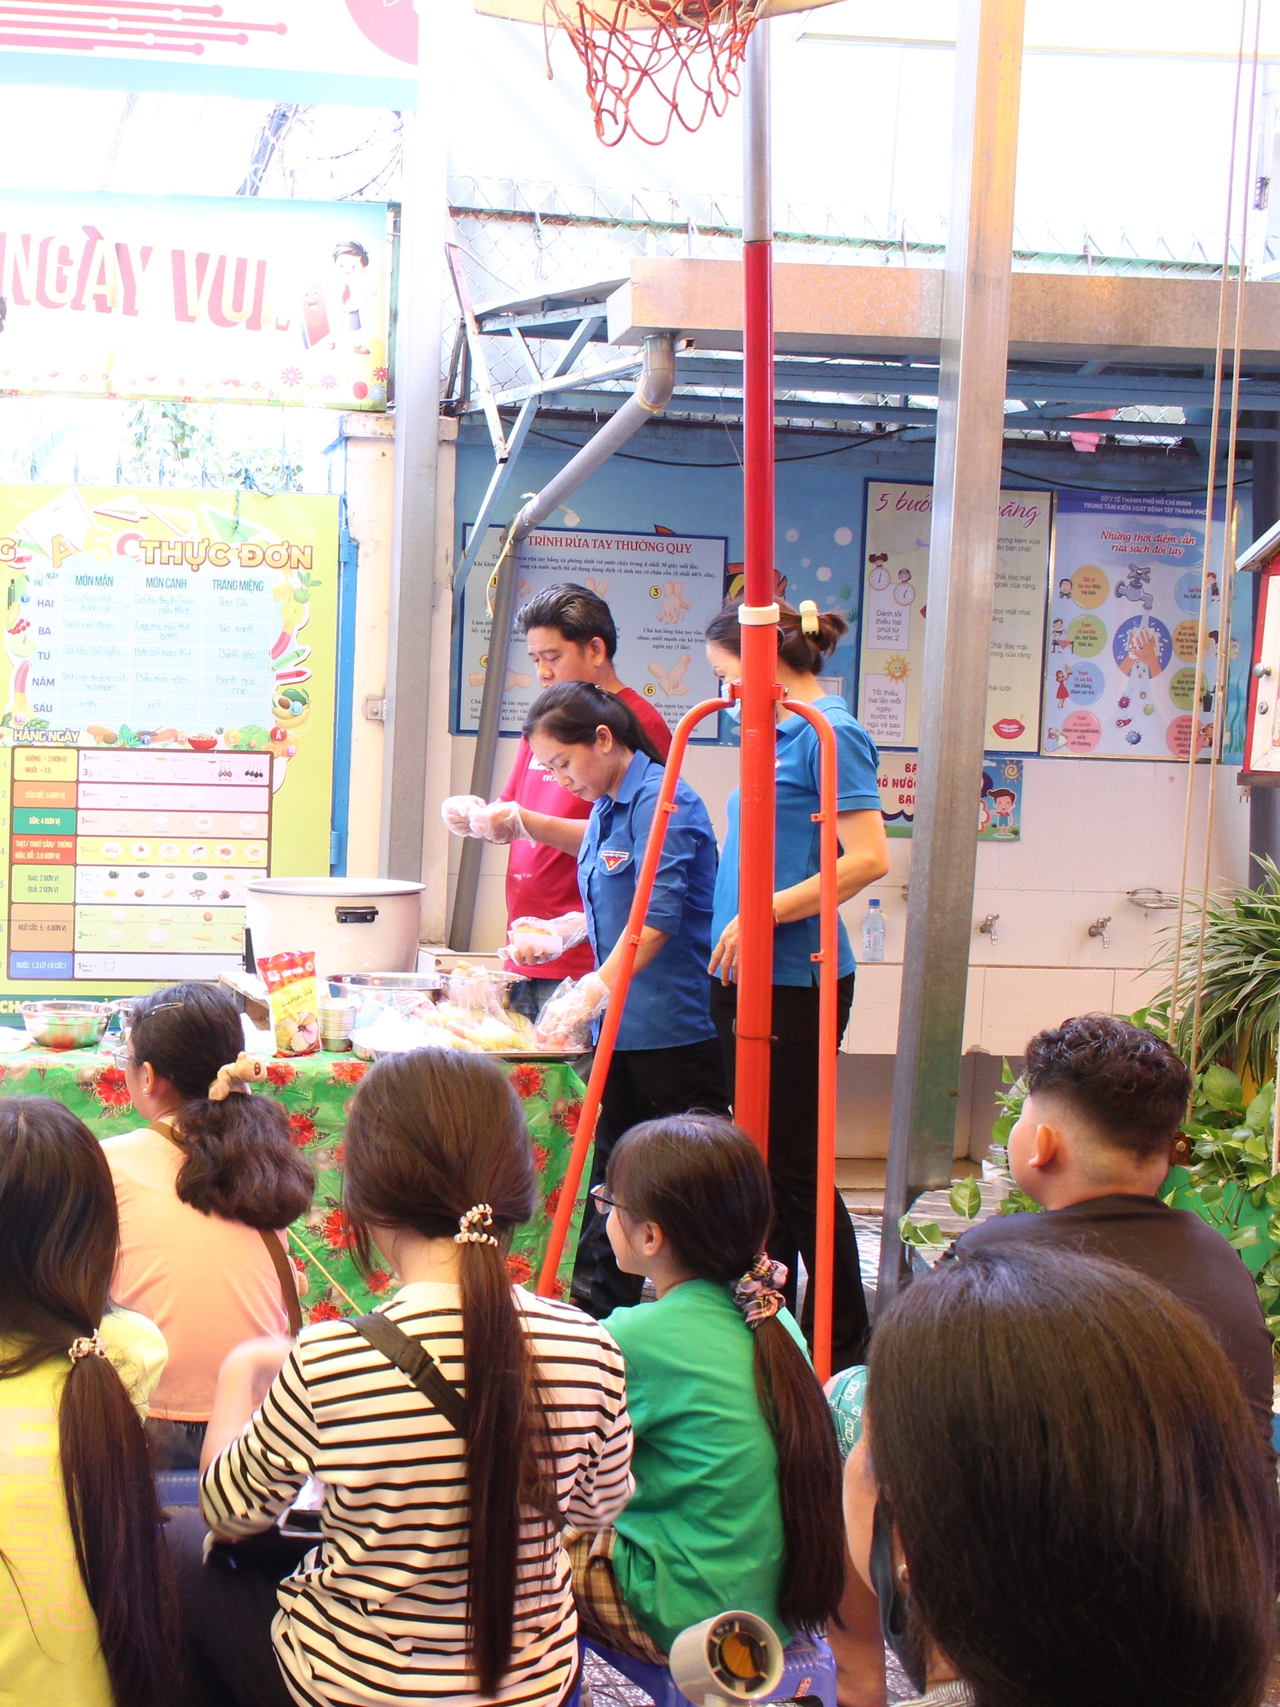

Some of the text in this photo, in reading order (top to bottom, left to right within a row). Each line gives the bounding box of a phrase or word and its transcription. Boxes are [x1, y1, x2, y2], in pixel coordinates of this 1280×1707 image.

[875, 492, 892, 512] 5
[895, 490, 932, 513] bướ
[1121, 495, 1141, 504] THÀNH
[1142, 495, 1155, 505] PHỐ
[1155, 497, 1165, 506] HỒ
[1165, 497, 1176, 506] CHÍ
[1176, 499, 1192, 507] MINH
[1083, 502, 1103, 510] TRUNG
[1104, 502, 1116, 510] TÂM
[1116, 502, 1131, 511] KIỂM
[1131, 504, 1147, 512] SOÁT
[1147, 505, 1163, 514] BỆNH
[1174, 506, 1194, 515] THÀNH
[1194, 507, 1207, 516] PHỐ
[528, 534, 693, 554] TRÌNH RỬA TAY THƯỜNG QUY
[1100, 530, 1196, 545] Những thời điểm cần
[139, 537, 314, 572] THỰC ĐƠN
[1111, 543, 1184, 558] rửa sạch đôi tay
[45, 571, 59, 580] NGÀY
[75, 573, 114, 590] MÓN MẶN
[146, 574, 187, 589] MÓN CANH
[212, 576, 264, 594] TRÁNG MIỆNG
[653, 587, 660, 597] 3
[37, 599, 54, 609] HAI
[38, 626, 51, 636] BA
[37, 650, 51, 661] TƯ
[31, 675, 55, 687] NĂM
[646, 685, 653, 695] 6
[33, 701, 53, 713] SÁU
[48, 727, 82, 744] NGÀY
[892, 776, 916, 789] NƯỚ
